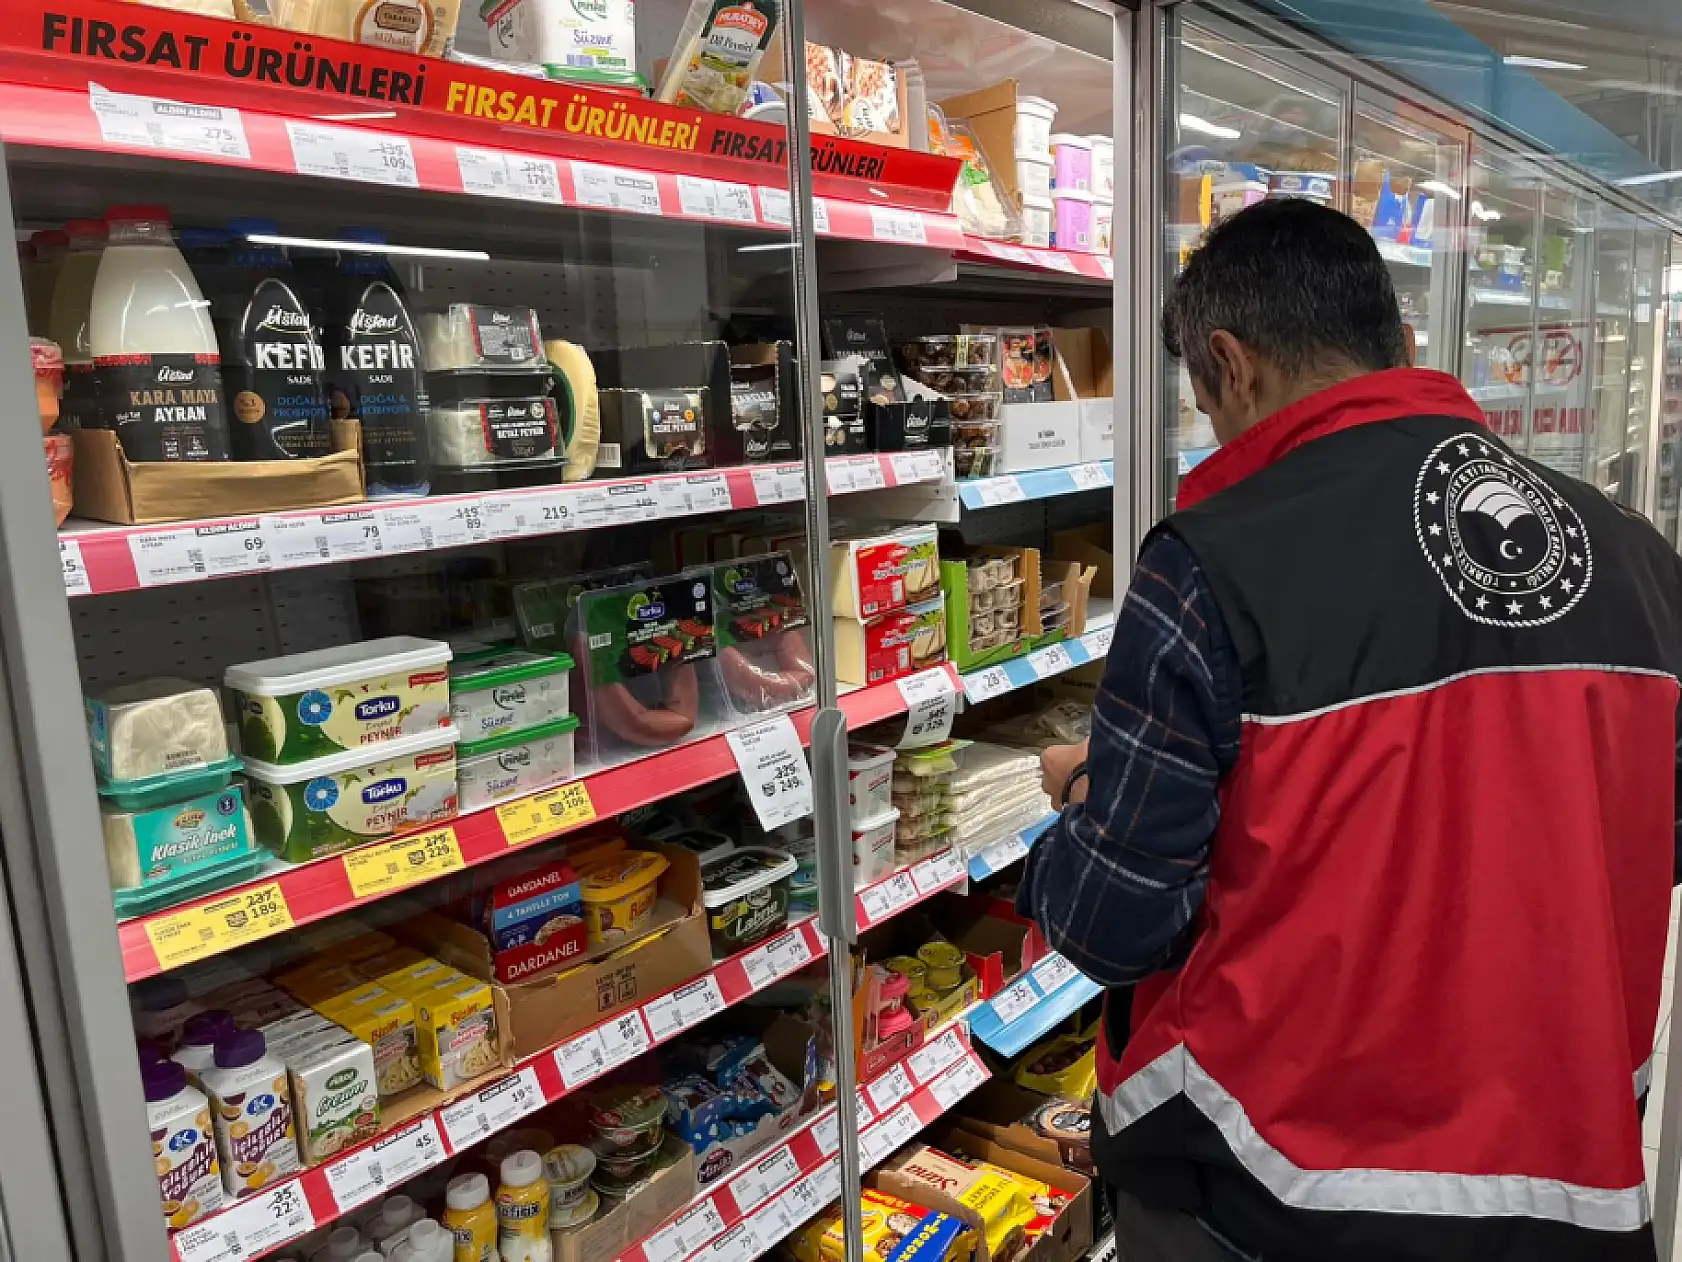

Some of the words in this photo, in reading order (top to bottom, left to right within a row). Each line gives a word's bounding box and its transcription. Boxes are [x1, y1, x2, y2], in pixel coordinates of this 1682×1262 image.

[41, 13, 209, 71] FIRSAT
[224, 31, 426, 107] ÜRÜNLERİ
[445, 80, 558, 129] FIRSAT
[565, 93, 703, 151] ÜRÜNLERİ
[709, 128, 787, 164] FIRSAT
[810, 141, 887, 180] RÜNLERİ
[340, 339, 415, 371] KEFİR
[130, 389, 177, 407] KARA
[154, 407, 207, 423] AYRAN
[543, 505, 568, 519] 219
[363, 524, 381, 538] 79
[245, 537, 263, 551] 69
[361, 699, 396, 717] Torku
[366, 781, 404, 800] Torku
[150, 835, 202, 862] Klasik
[203, 822, 236, 847] İnek
[508, 871, 563, 898] DARDANEL
[252, 902, 277, 919] 189
[507, 939, 581, 980] DARDANEL
